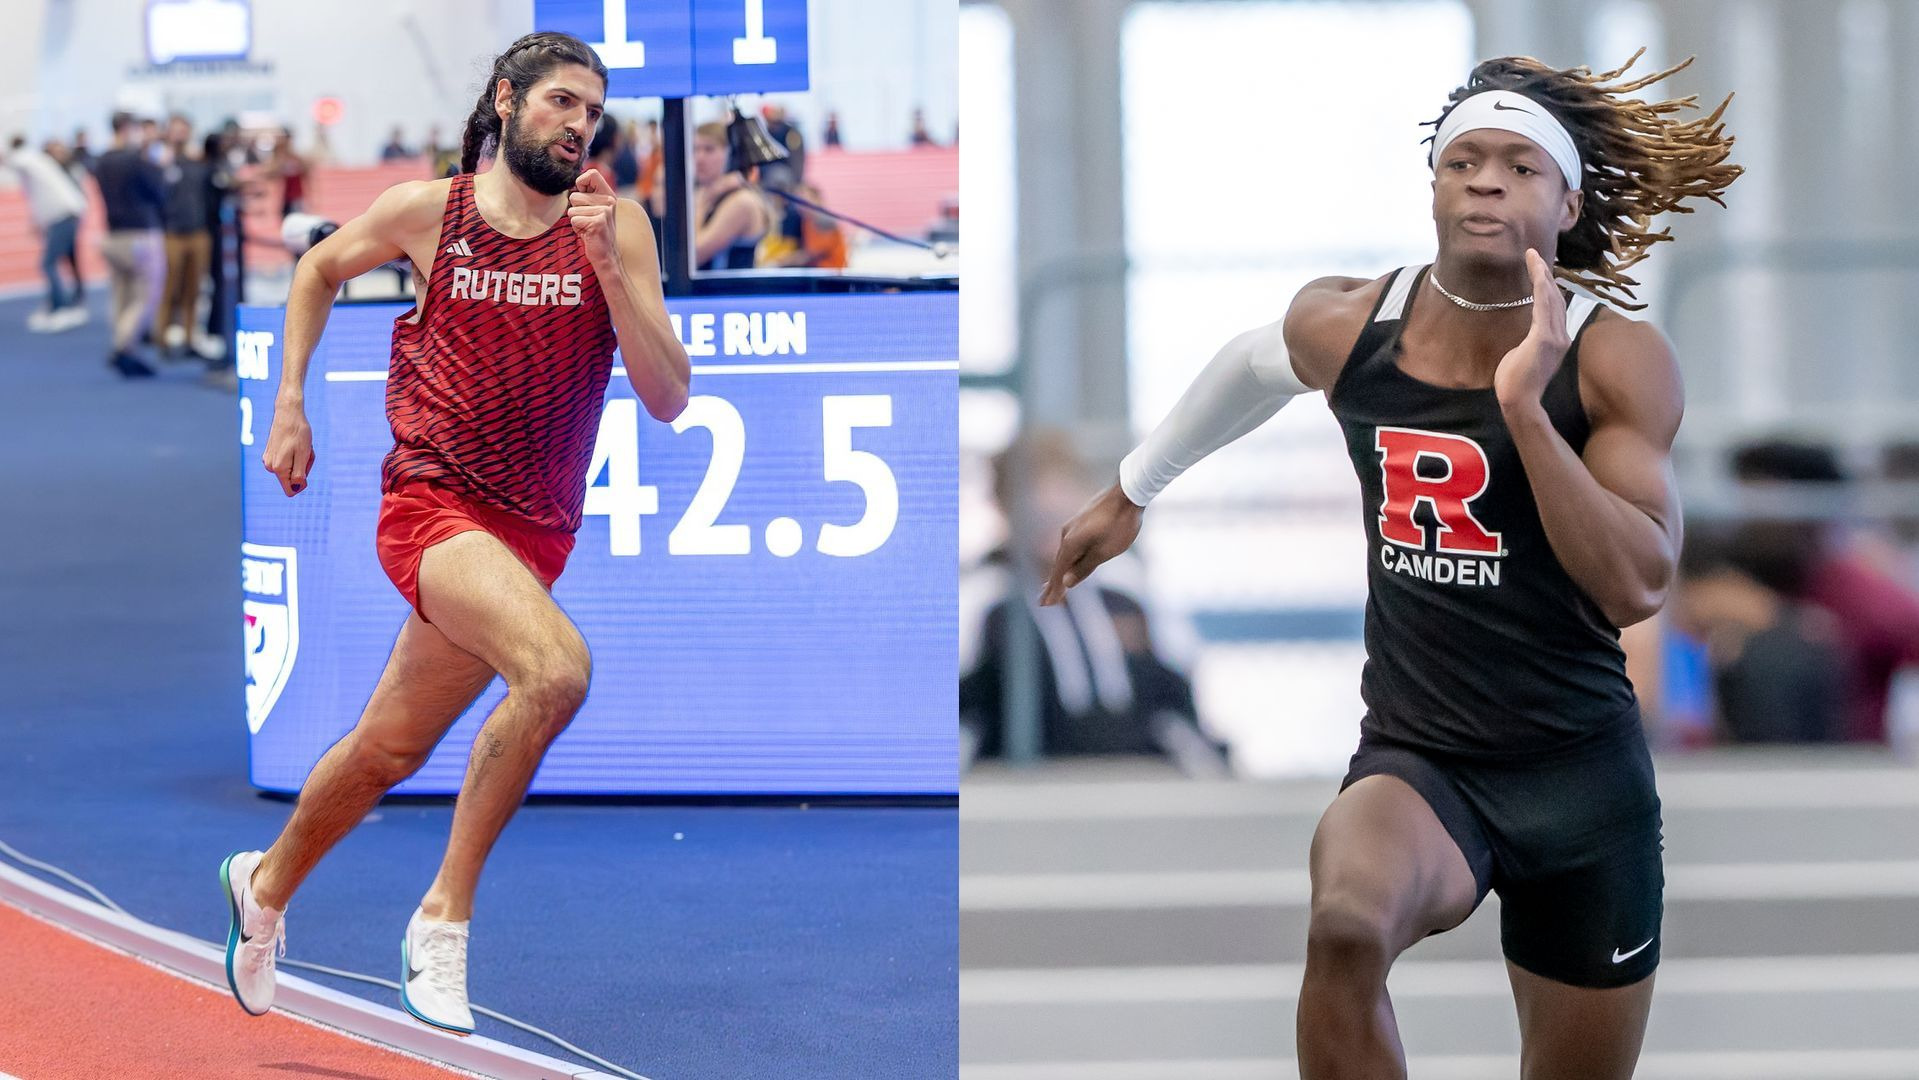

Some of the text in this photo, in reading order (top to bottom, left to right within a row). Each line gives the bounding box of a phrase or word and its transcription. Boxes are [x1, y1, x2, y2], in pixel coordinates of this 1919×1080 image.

[451, 267, 582, 306] RUTGERS
[723, 311, 807, 356] RUN
[583, 394, 899, 557] 42.5
[1375, 426, 1502, 557] R
[1381, 544, 1500, 586] CAMDEN
